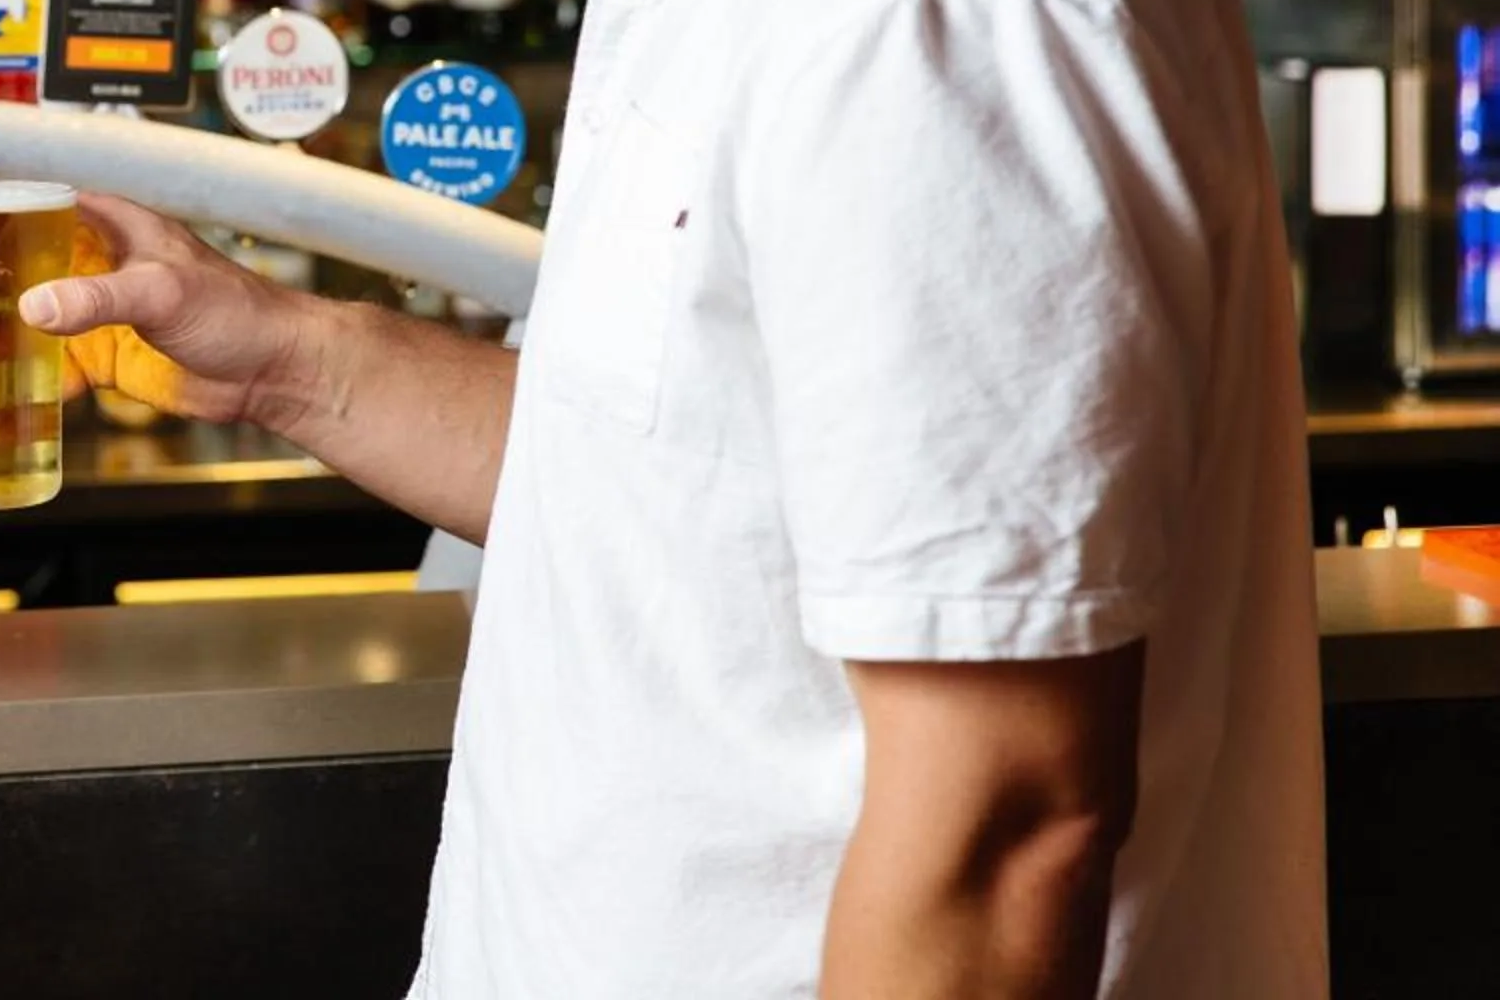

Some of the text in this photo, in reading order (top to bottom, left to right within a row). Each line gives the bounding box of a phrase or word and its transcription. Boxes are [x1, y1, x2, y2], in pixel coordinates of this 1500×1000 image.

[232, 64, 335, 91] PERONI
[392, 120, 517, 152] PALE ALE
